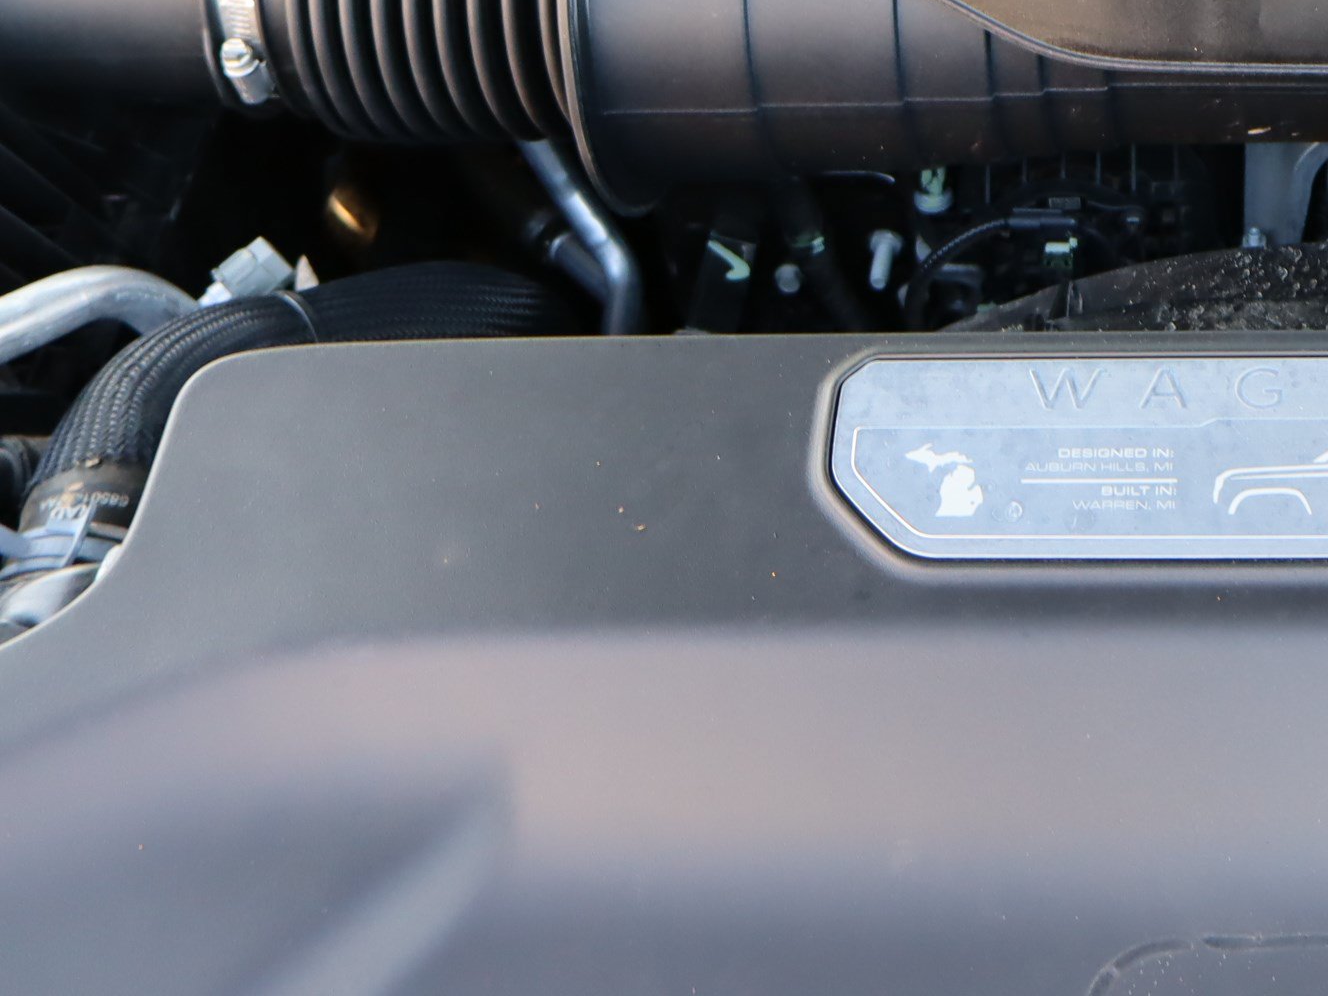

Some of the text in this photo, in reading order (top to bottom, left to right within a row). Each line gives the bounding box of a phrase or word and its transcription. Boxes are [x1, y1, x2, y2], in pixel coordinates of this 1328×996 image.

[1058, 447, 1174, 458] DESIGNED IN:
[1025, 462, 1096, 472] AUBURN
[1154, 462, 1173, 472] MI
[1101, 485, 1177, 496] BUILT IN:
[1156, 500, 1175, 510] MI
